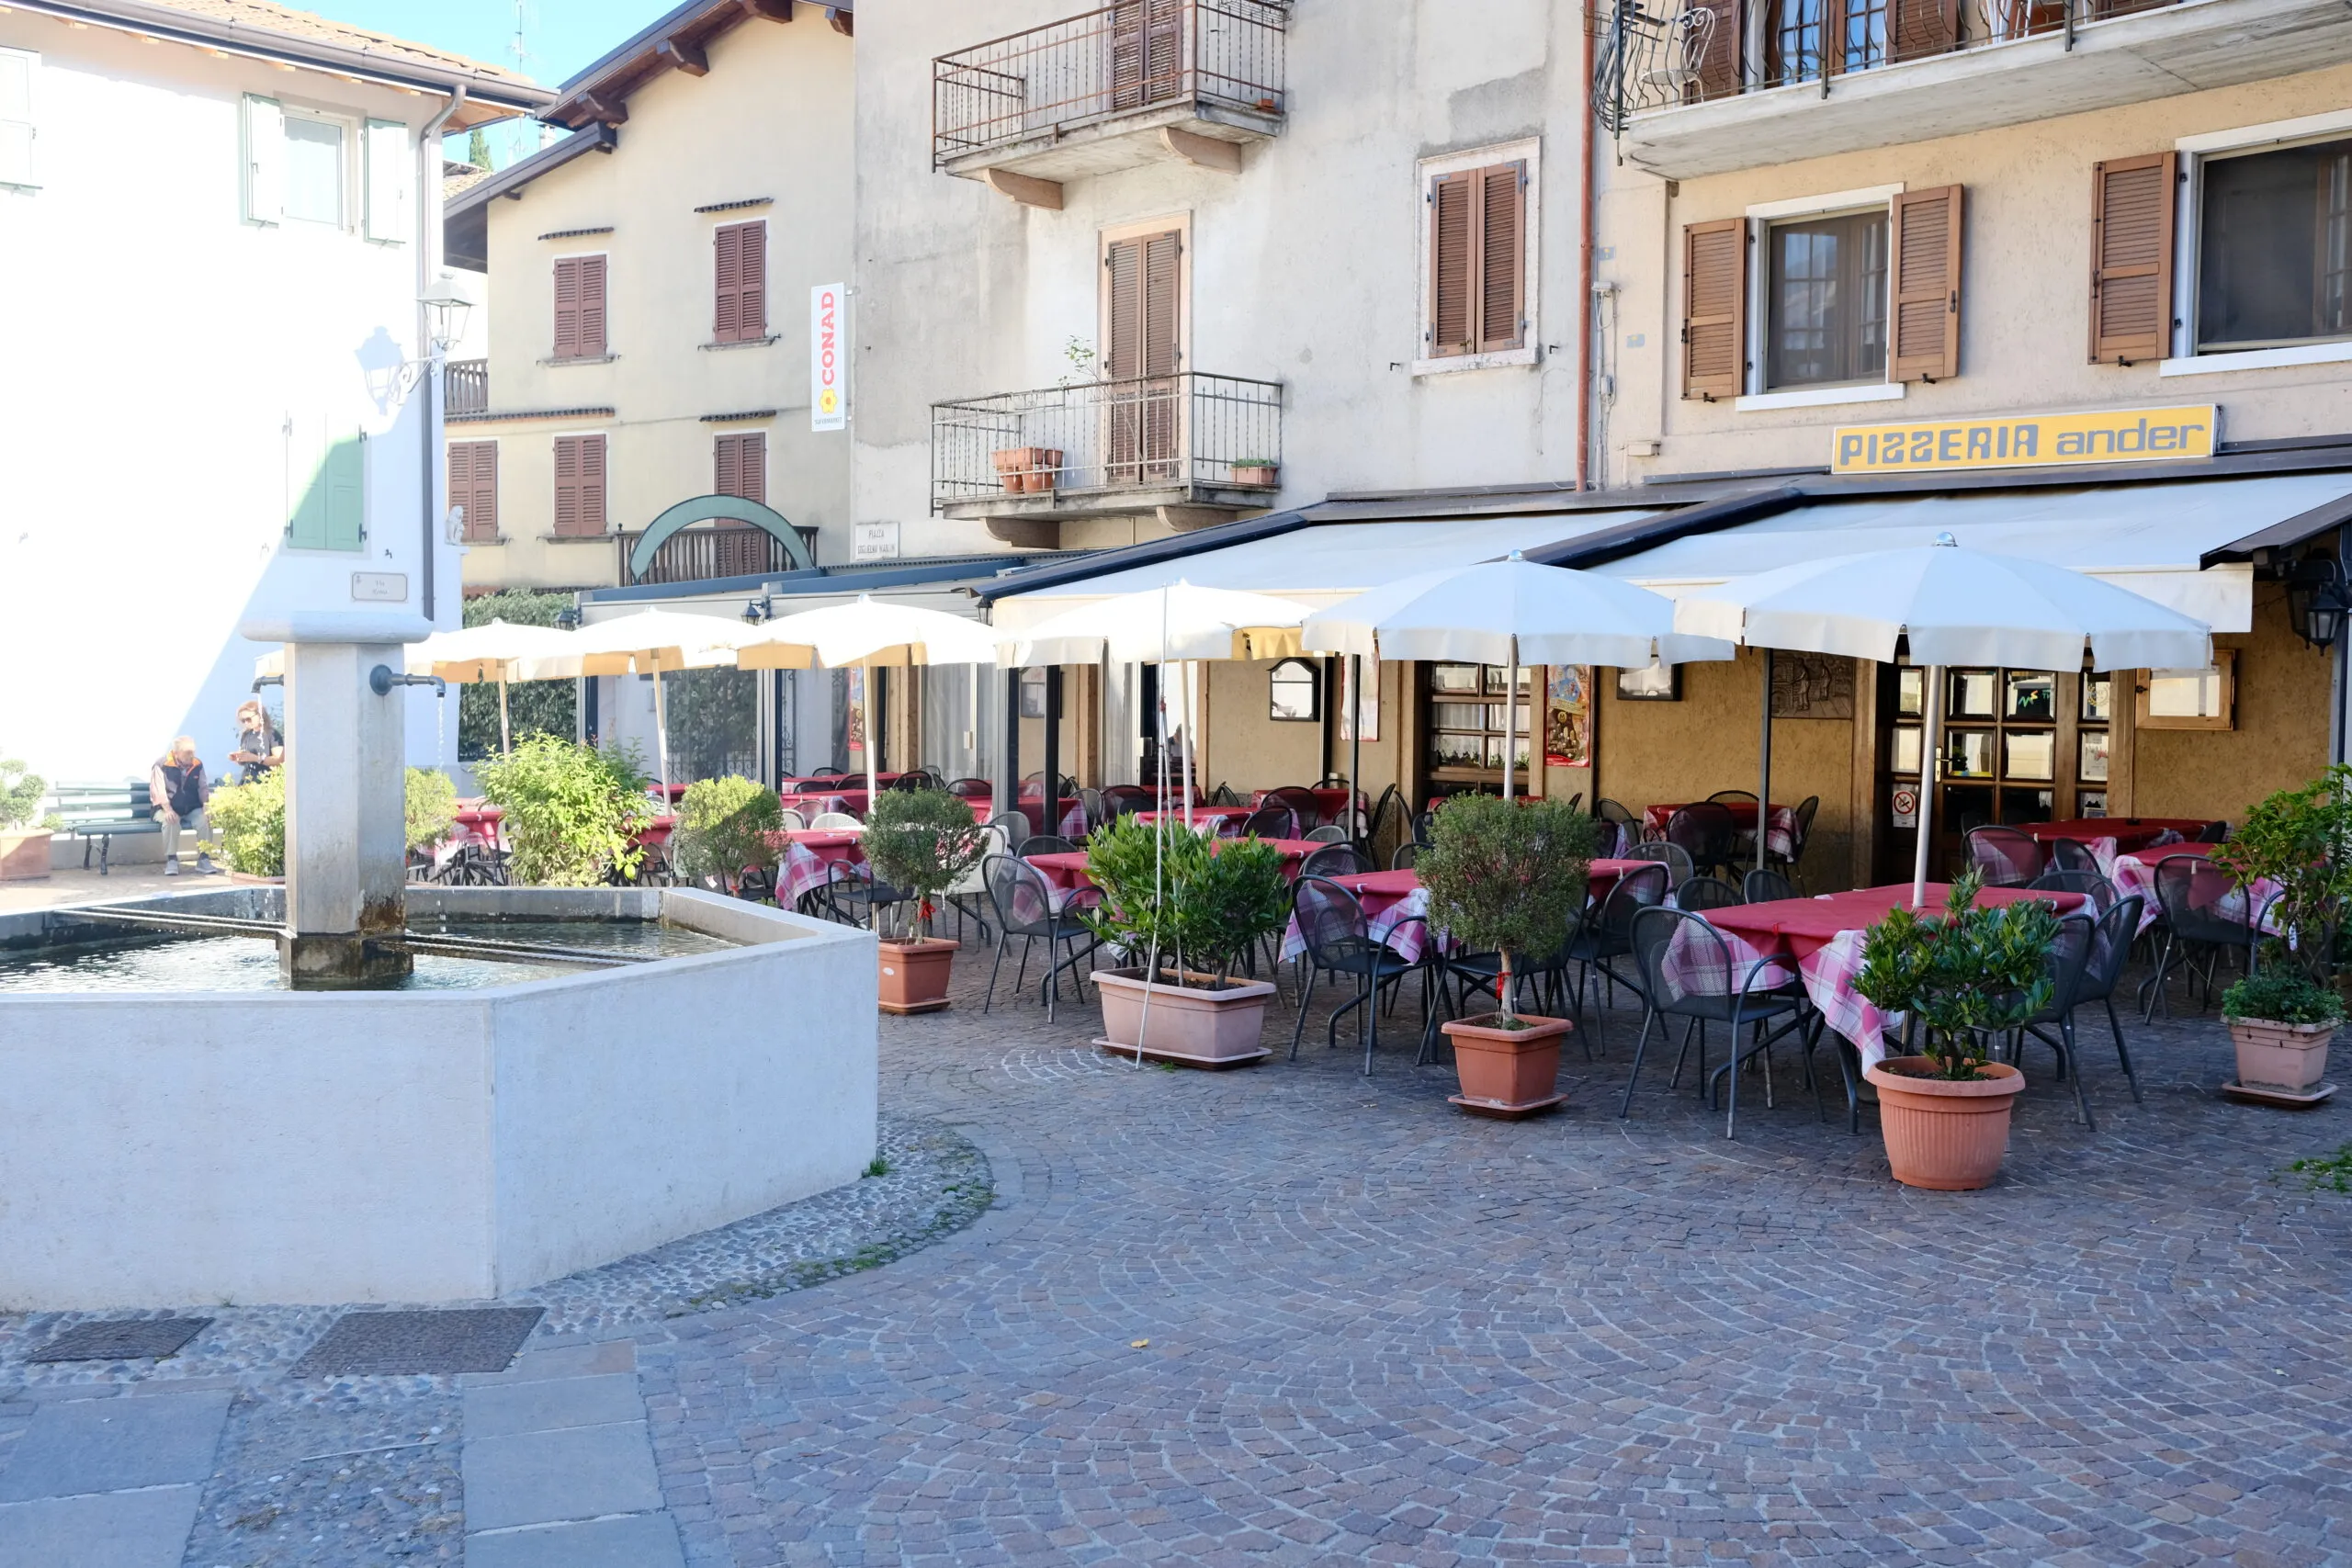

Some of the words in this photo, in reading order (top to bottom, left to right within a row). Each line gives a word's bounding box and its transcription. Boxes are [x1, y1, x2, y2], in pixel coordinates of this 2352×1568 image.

[821, 291, 834, 386] CONAD
[1839, 424, 2039, 465] PIZZERIA
[2056, 418, 2204, 456] ander
